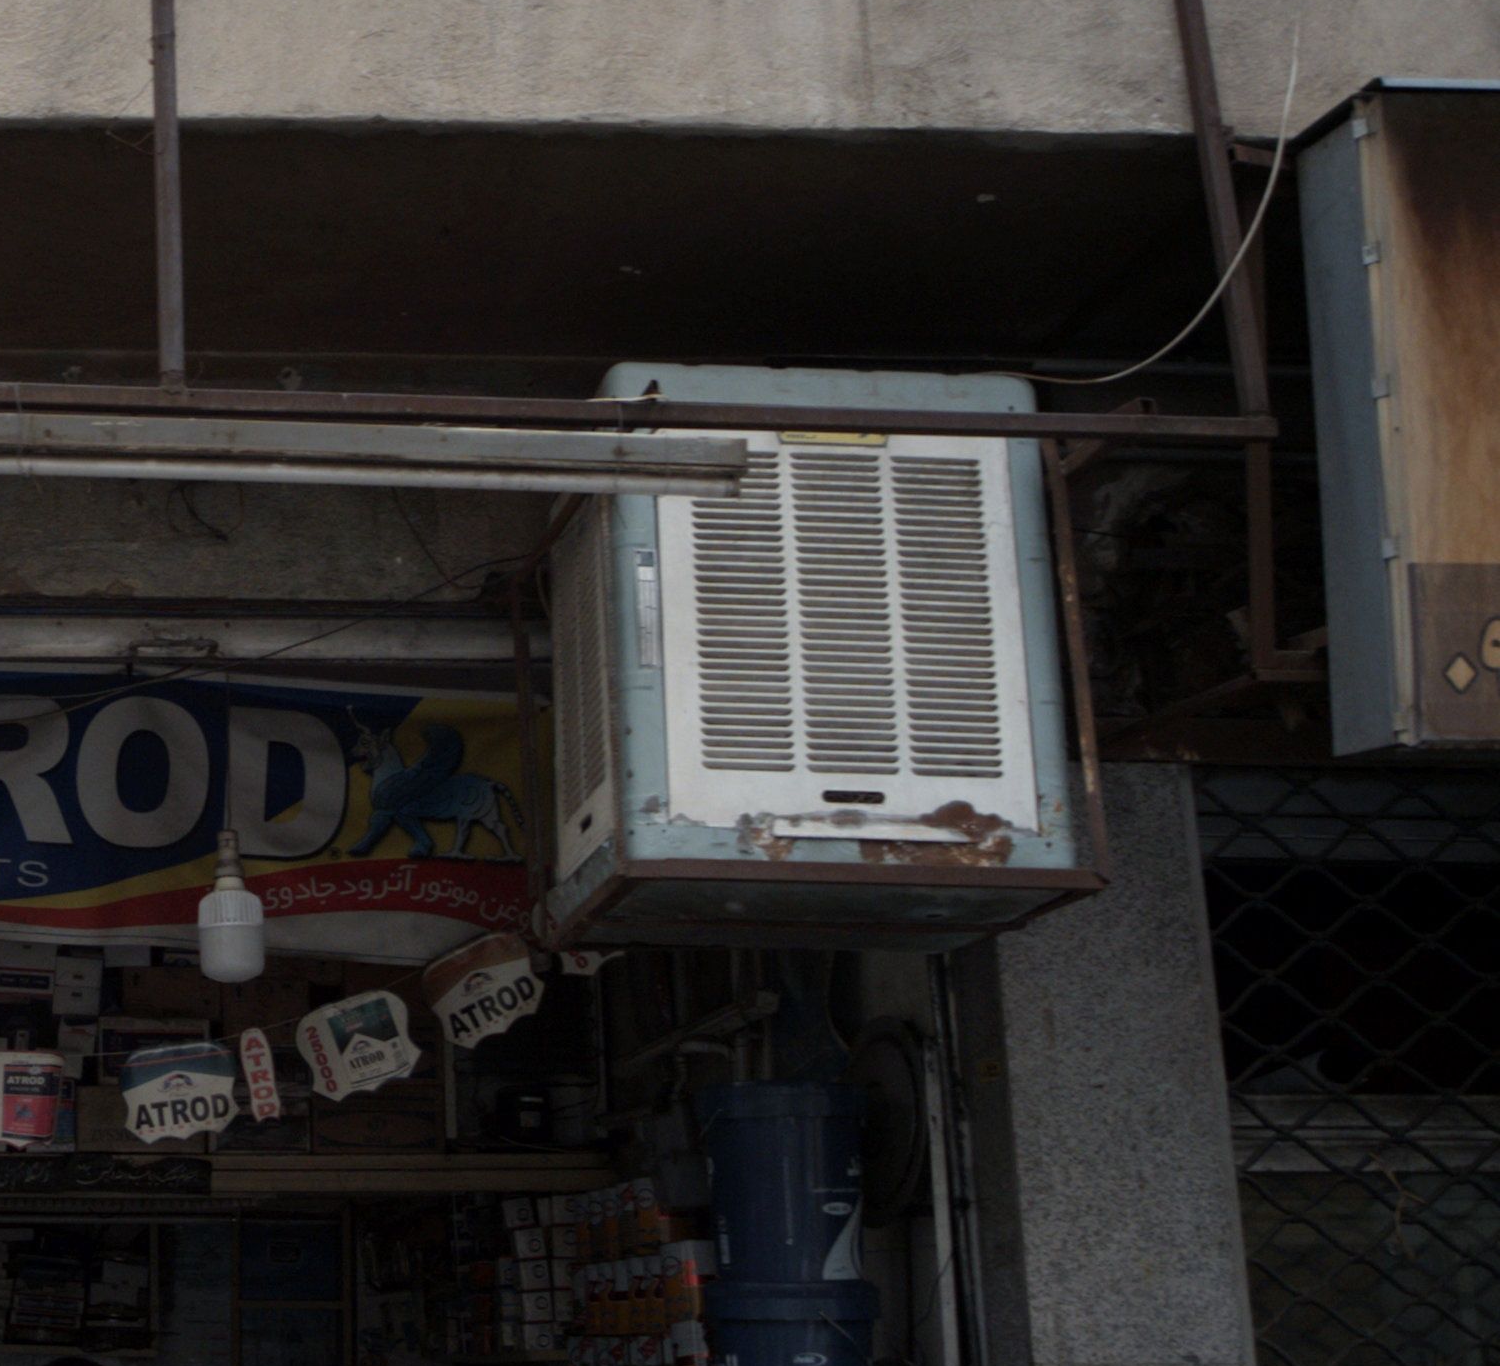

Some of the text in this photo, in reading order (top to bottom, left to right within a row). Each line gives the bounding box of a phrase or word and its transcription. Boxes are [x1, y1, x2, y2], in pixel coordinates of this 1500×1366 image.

[343, 864, 418, 901] آترود
[410, 875, 480, 910] موتور
[450, 975, 535, 1038] ATROD
[244, 1036, 277, 1116] ATROD
[304, 1025, 338, 1094] 25000
[6, 1075, 46, 1086] ATROD
[135, 1093, 230, 1130] ATROD
